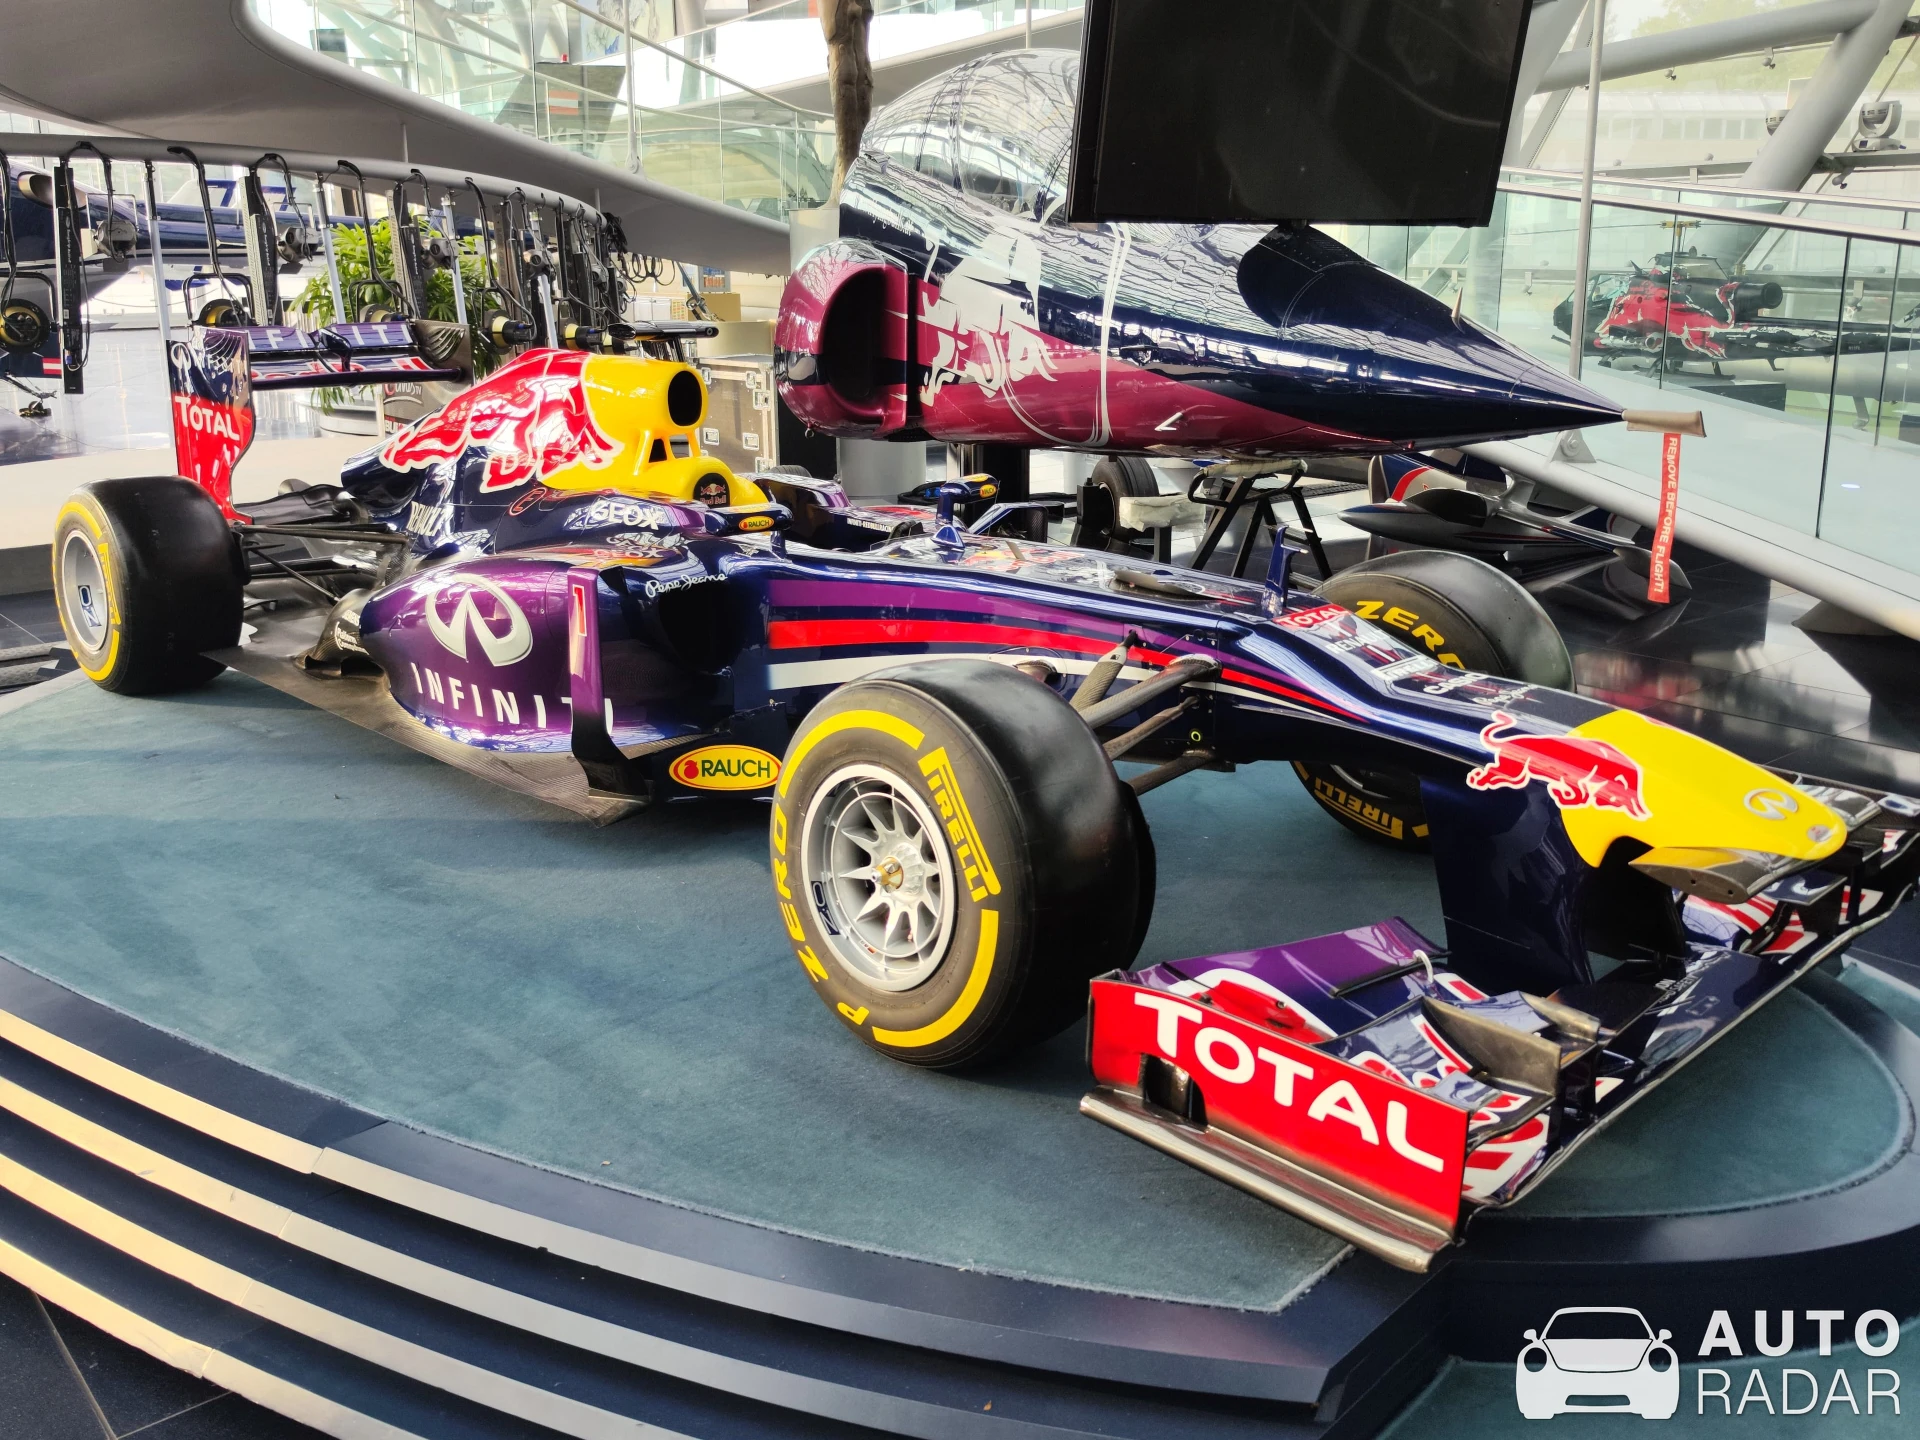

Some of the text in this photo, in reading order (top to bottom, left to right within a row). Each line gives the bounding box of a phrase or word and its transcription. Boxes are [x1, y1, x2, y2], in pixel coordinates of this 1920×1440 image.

[174, 395, 241, 441] TOTAL
[590, 499, 659, 531] GEOX
[748, 520, 770, 528] RAUCH
[1653, 437, 1678, 593] REMOVE BEFORE FLIGHT!
[645, 573, 728, 598] Pepe Jeans
[572, 584, 588, 637] 1
[1277, 606, 1350, 628] TOTAL
[1423, 672, 1488, 694] CASIO
[701, 759, 771, 778] RAUCH
[918, 746, 1002, 903] PIRELLI
[1314, 776, 1404, 841] PIRELLI
[773, 803, 870, 1026] P ZERO
[1134, 991, 1445, 1173] TOTAL
